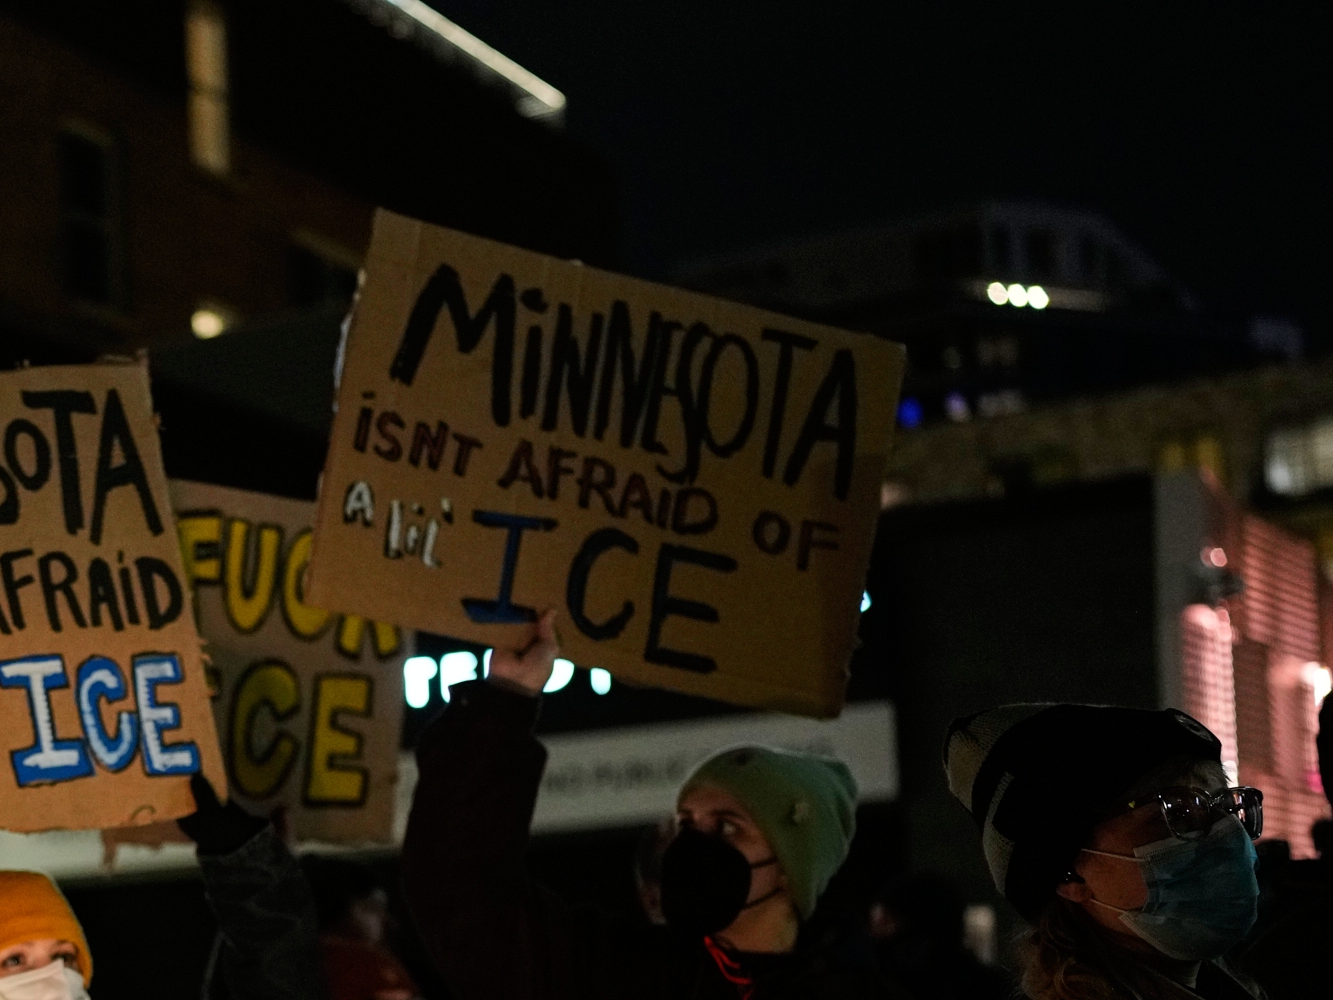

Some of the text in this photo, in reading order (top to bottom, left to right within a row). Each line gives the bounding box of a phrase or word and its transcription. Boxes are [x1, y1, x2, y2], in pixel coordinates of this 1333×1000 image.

[343, 480, 375, 528] A
[460, 508, 738, 675] ICE
[498, 438, 719, 535] AFRAID
[752, 509, 841, 571] OF
[207, 658, 373, 807] CE
